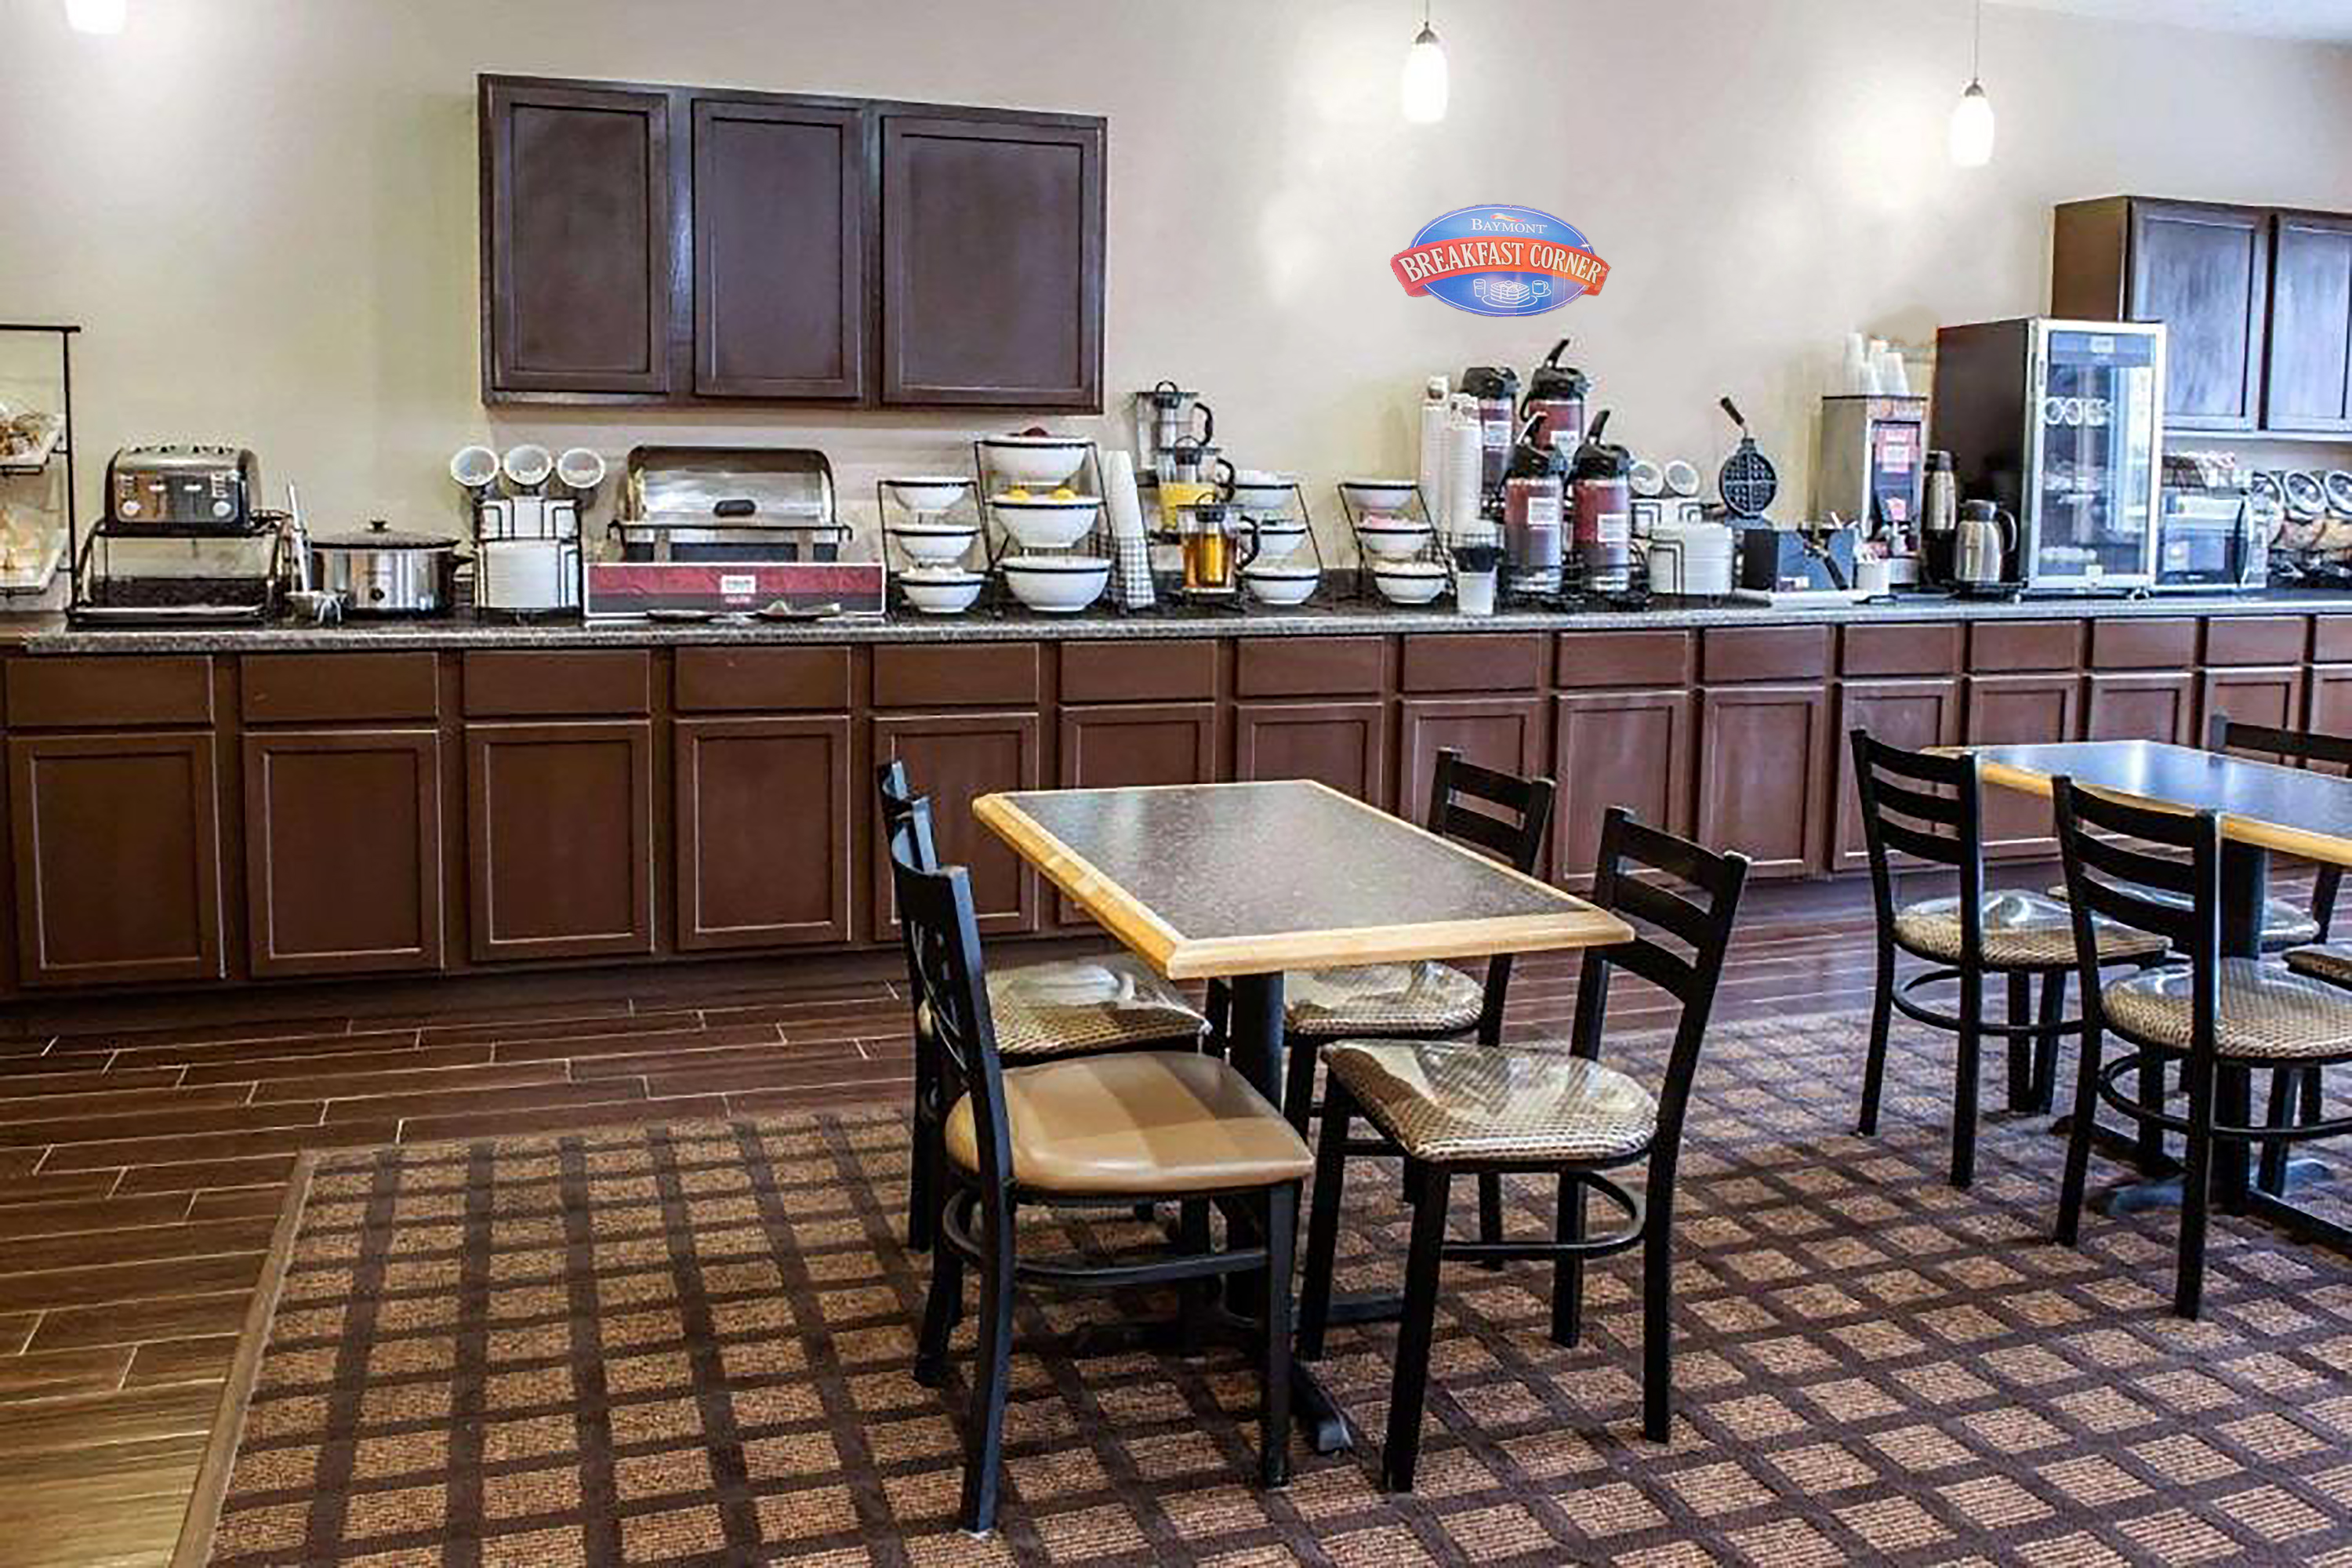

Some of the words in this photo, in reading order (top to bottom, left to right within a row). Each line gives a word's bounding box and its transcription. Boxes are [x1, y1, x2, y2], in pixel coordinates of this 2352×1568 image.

[1470, 218, 1545, 234] BAYMONT
[1398, 241, 1525, 283] BREAKFAST
[1530, 243, 1602, 284] CORNER
